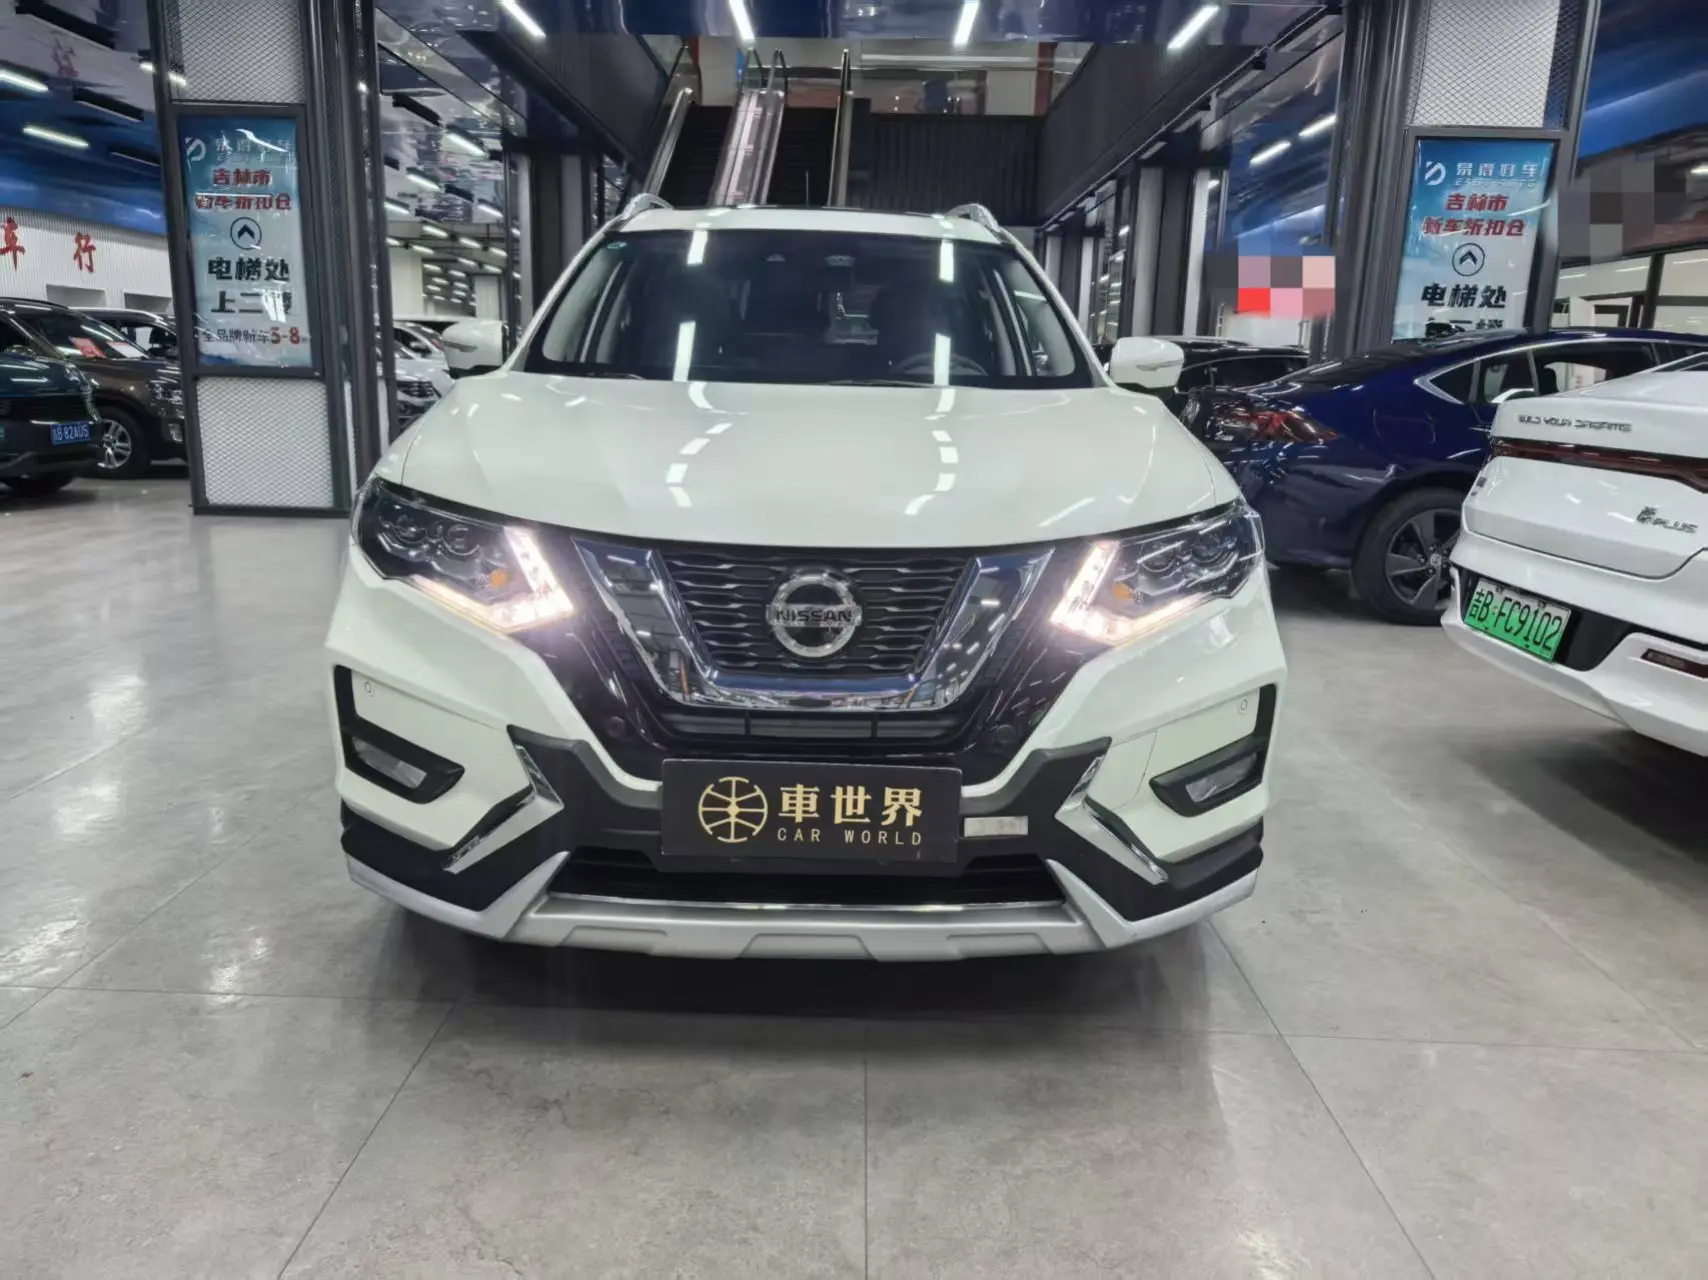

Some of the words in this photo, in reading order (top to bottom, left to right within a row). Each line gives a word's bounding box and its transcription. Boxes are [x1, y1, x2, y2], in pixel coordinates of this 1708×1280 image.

[212, 168, 271, 186] 吉林市
[1446, 193, 1510, 212] 吉林市
[1423, 216, 1526, 236] 新车折扣仓
[208, 256, 291, 281] 电梯处
[1421, 283, 1507, 309] 电梯处
[776, 607, 852, 622] NISSAN
[778, 784, 922, 827] 車世界
[777, 828, 821, 842] CAR
[844, 829, 922, 845] WORLD
